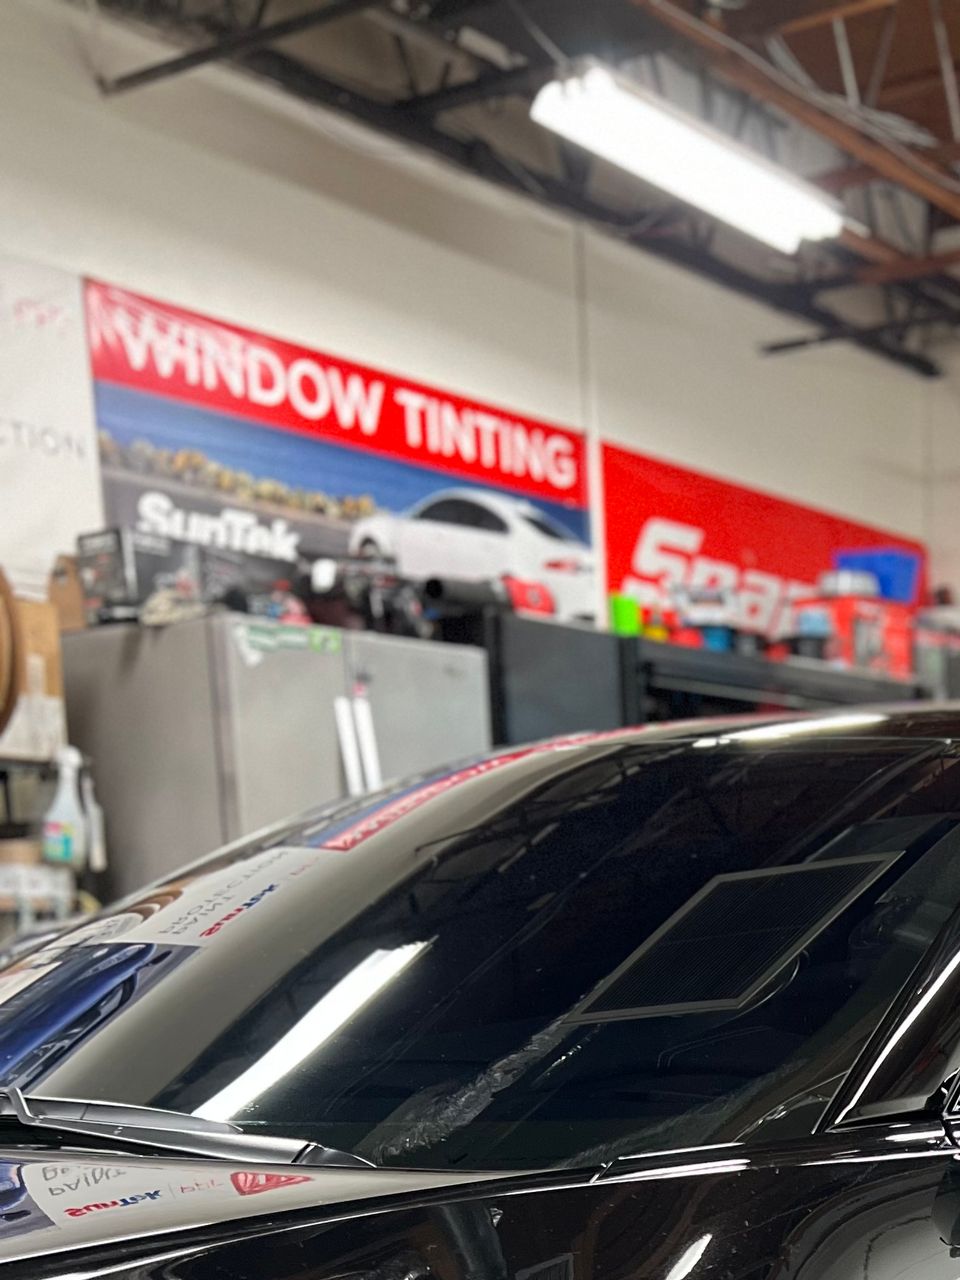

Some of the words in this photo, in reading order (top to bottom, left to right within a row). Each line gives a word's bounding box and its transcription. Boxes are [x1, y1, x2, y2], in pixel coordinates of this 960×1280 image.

[110, 303, 385, 437] WINDOW
[393, 386, 578, 490] TINTING
[134, 491, 300, 561] SunTek
